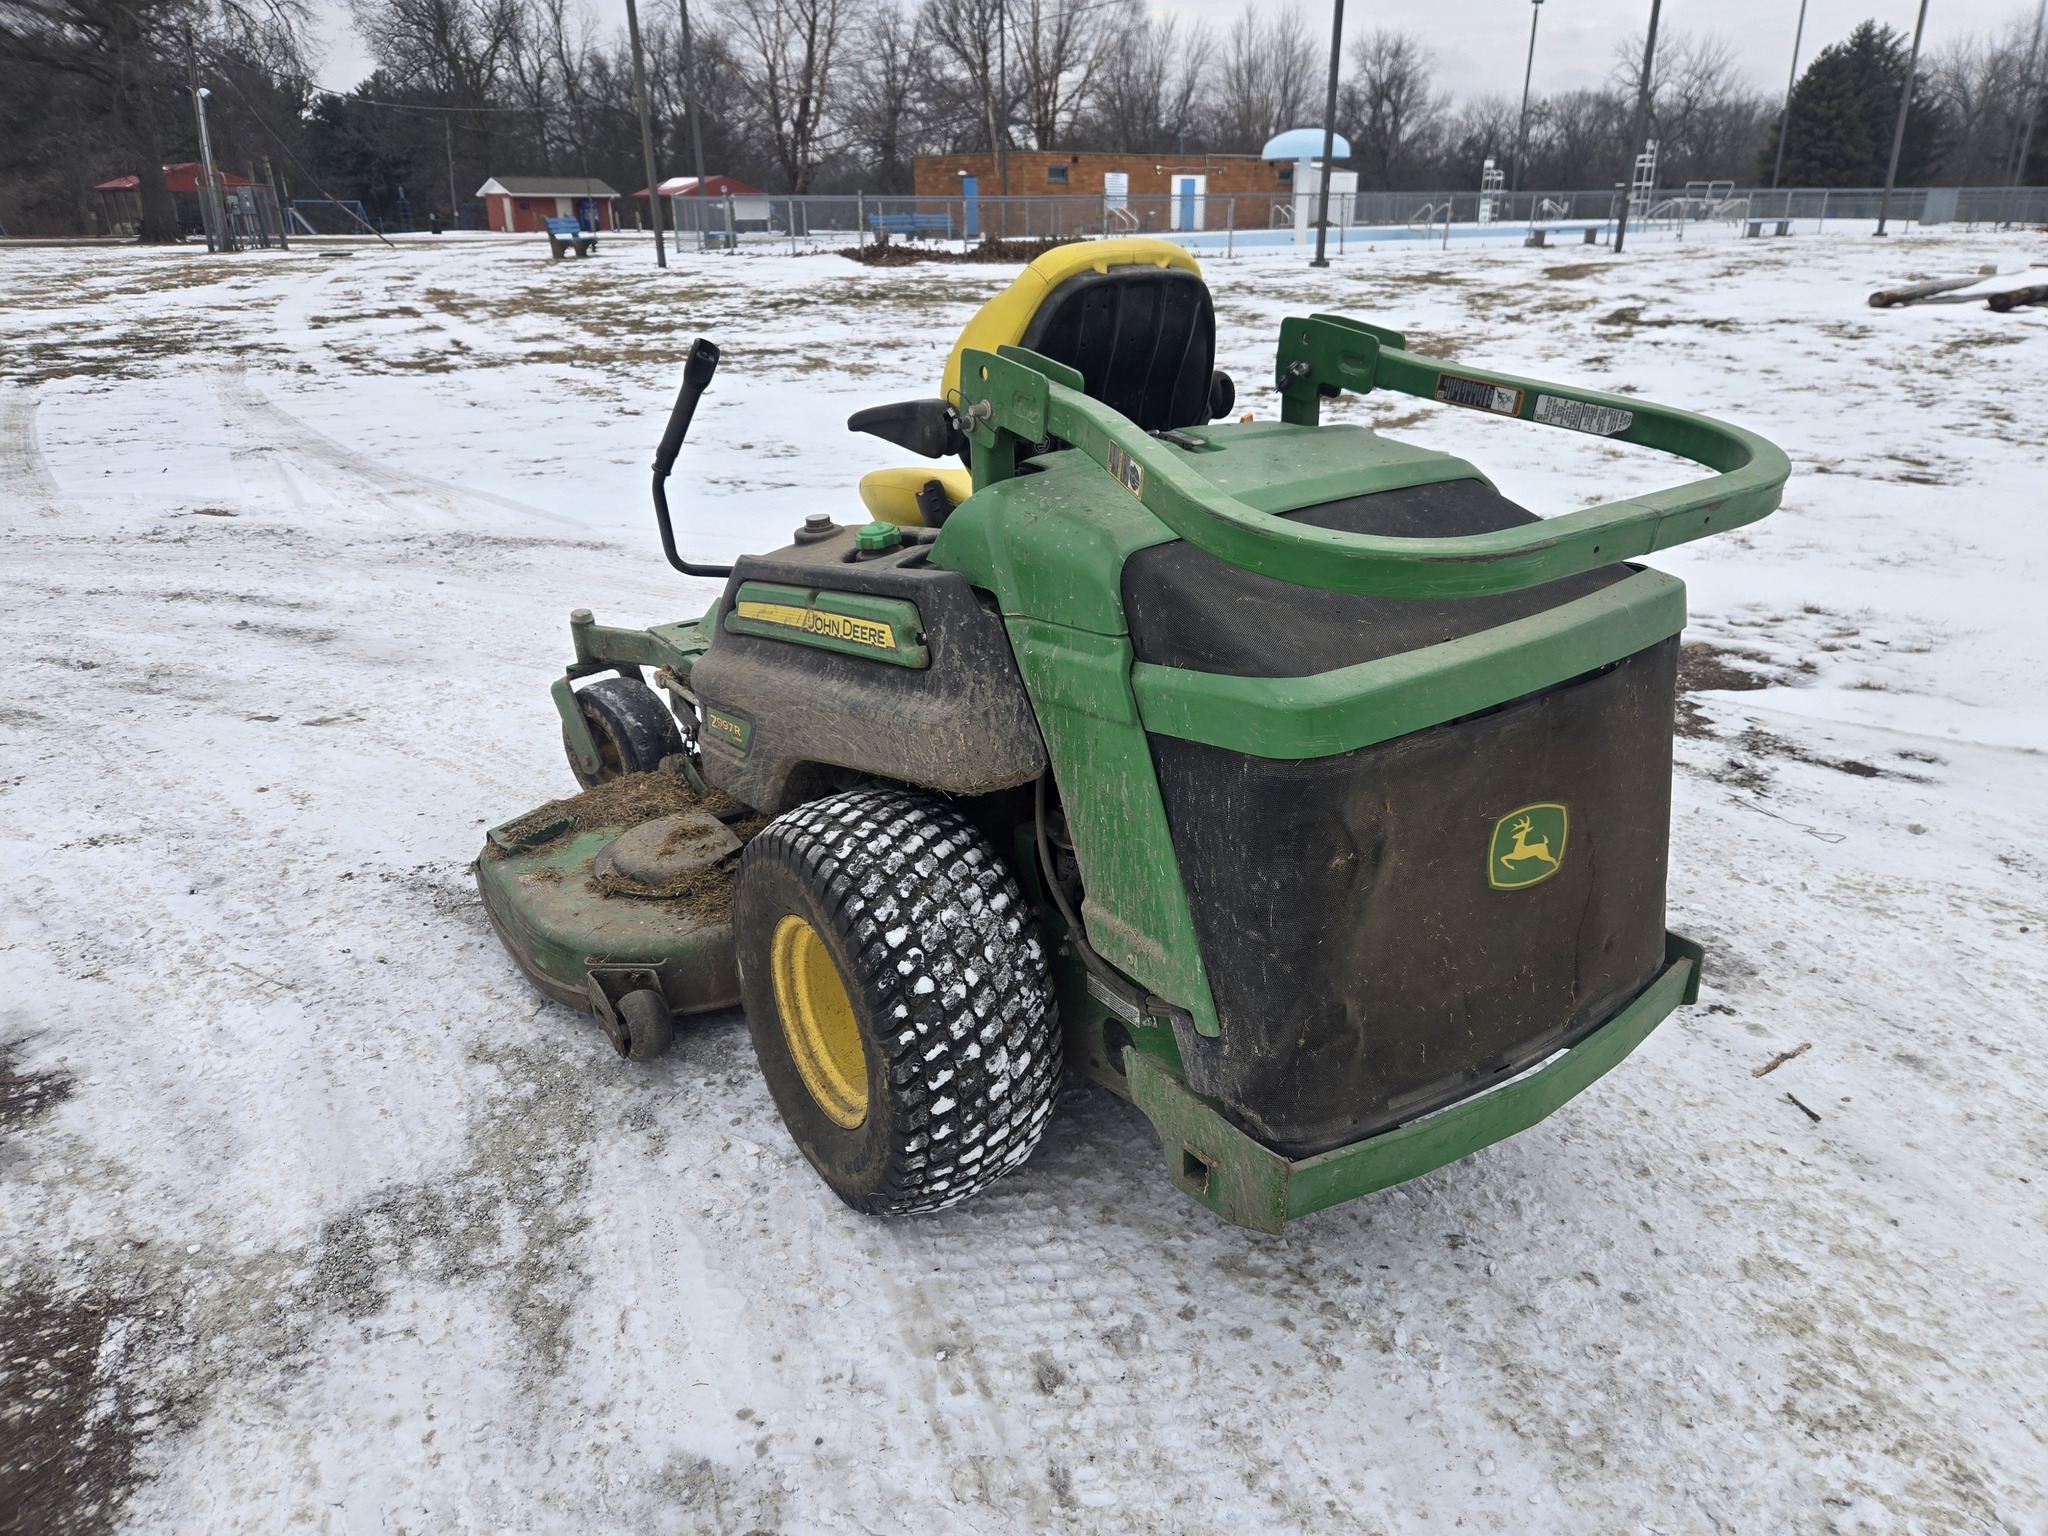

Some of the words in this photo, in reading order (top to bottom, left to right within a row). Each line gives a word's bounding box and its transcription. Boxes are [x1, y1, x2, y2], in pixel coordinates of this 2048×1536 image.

[807, 610, 840, 636] JOHN
[843, 618, 886, 646] DEERE
[710, 714, 741, 737] Z997R
